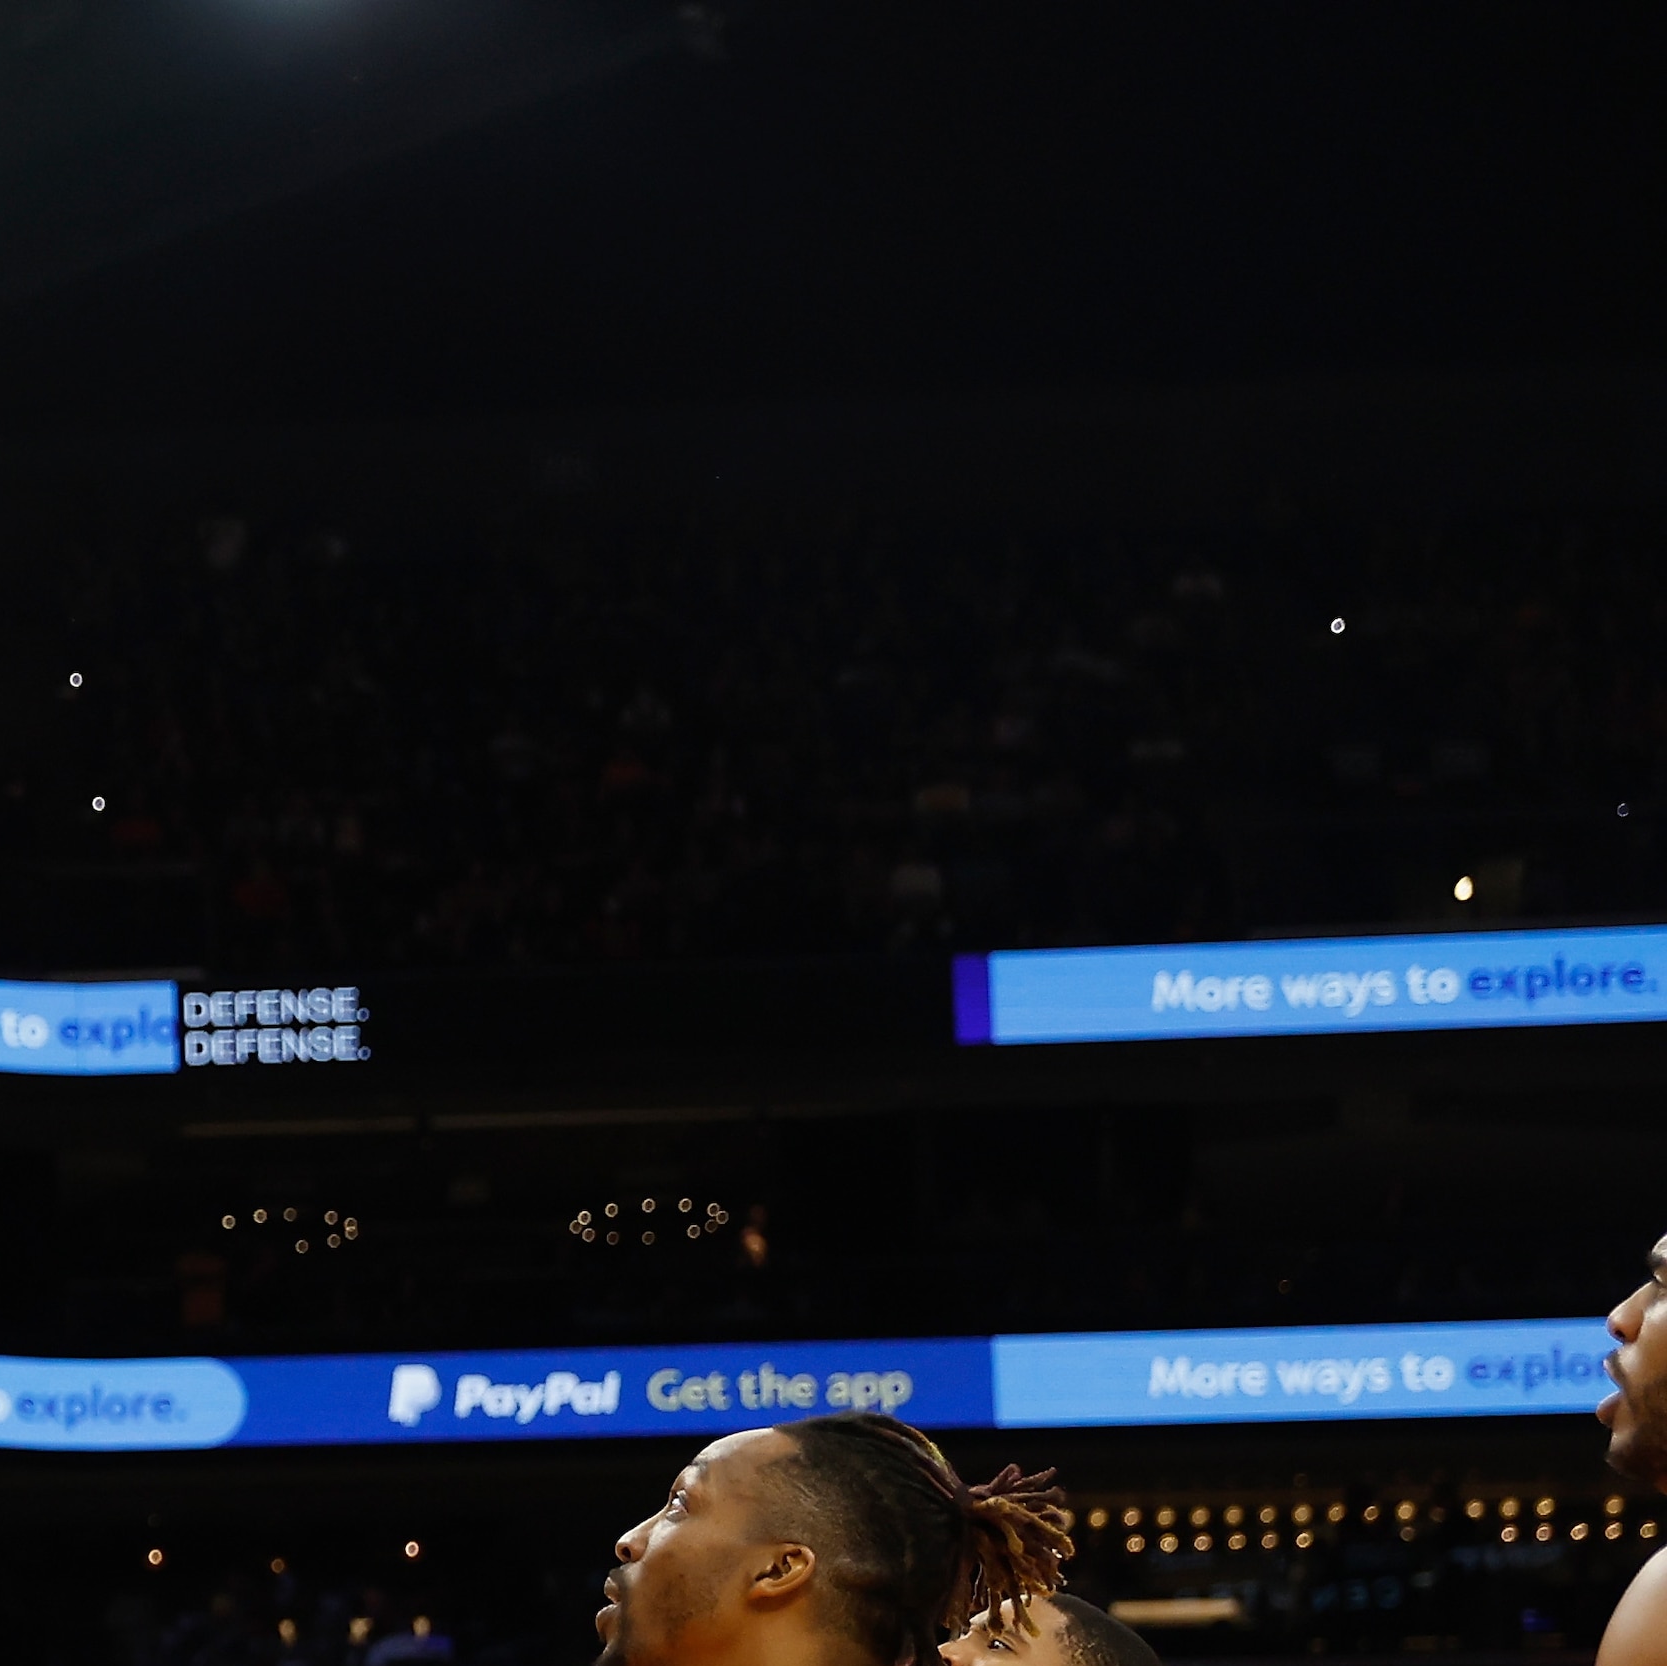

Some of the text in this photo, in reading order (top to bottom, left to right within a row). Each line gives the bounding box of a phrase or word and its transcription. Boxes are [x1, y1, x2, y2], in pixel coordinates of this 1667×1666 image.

[183, 987, 371, 1028] DEFENSE.
[1150, 968, 1274, 1013] More
[1281, 971, 1398, 1018] ways
[1404, 962, 1460, 1005] to
[0, 1009, 49, 1049] to
[183, 1025, 372, 1067] DEFENSE.
[453, 1361, 913, 1426] PayPal Get the app
[1148, 1353, 1267, 1401] More
[1275, 1355, 1392, 1406] ways
[1400, 1349, 1456, 1393] to
